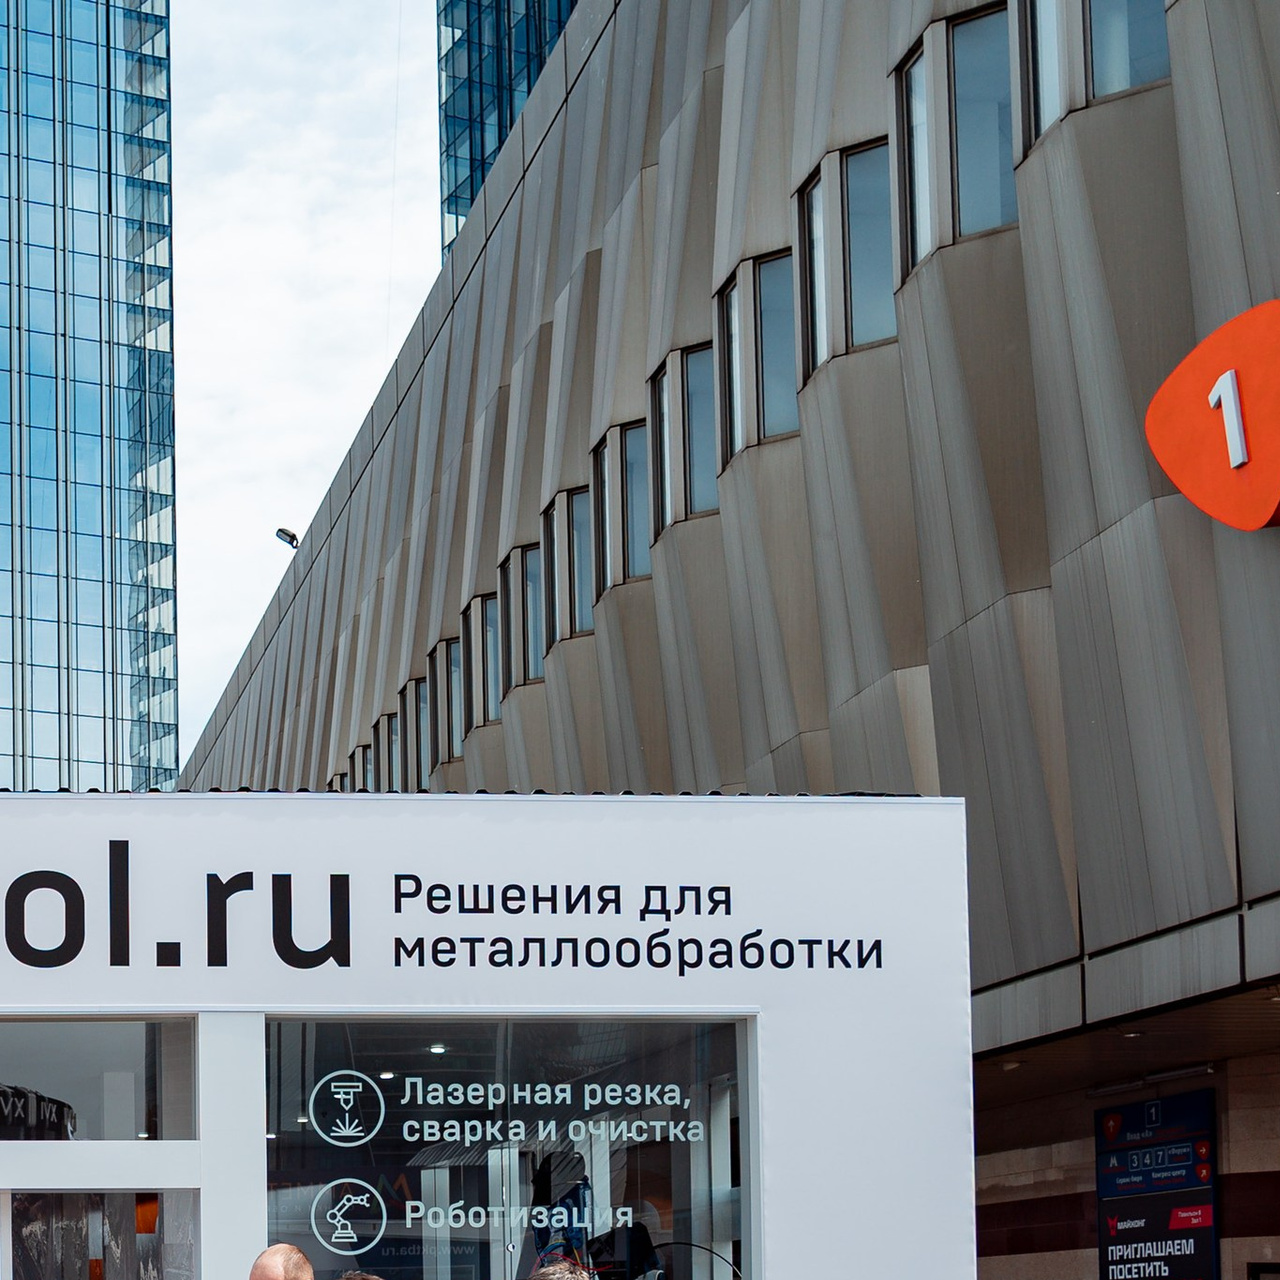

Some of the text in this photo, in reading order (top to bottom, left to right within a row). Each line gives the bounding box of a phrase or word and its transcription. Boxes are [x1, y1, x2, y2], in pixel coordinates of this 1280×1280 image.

[1207, 368, 1249, 470] 1
[393, 873, 732, 922] Решения для
[393, 928, 884, 977] металлообработки
[401, 1077, 692, 1110] Лазерная резка,
[402, 1119, 705, 1147] сварка и очистка
[1132, 1155, 1138, 1167] 3
[1144, 1153, 1151, 1165] 4
[1157, 1151, 1163, 1163] 7
[405, 1201, 633, 1232] Роботизация
[1108, 1239, 1195, 1261] ПРИГЛАШАЕМ
[1109, 1261, 1169, 1280] ПОСЕТИТЬ
